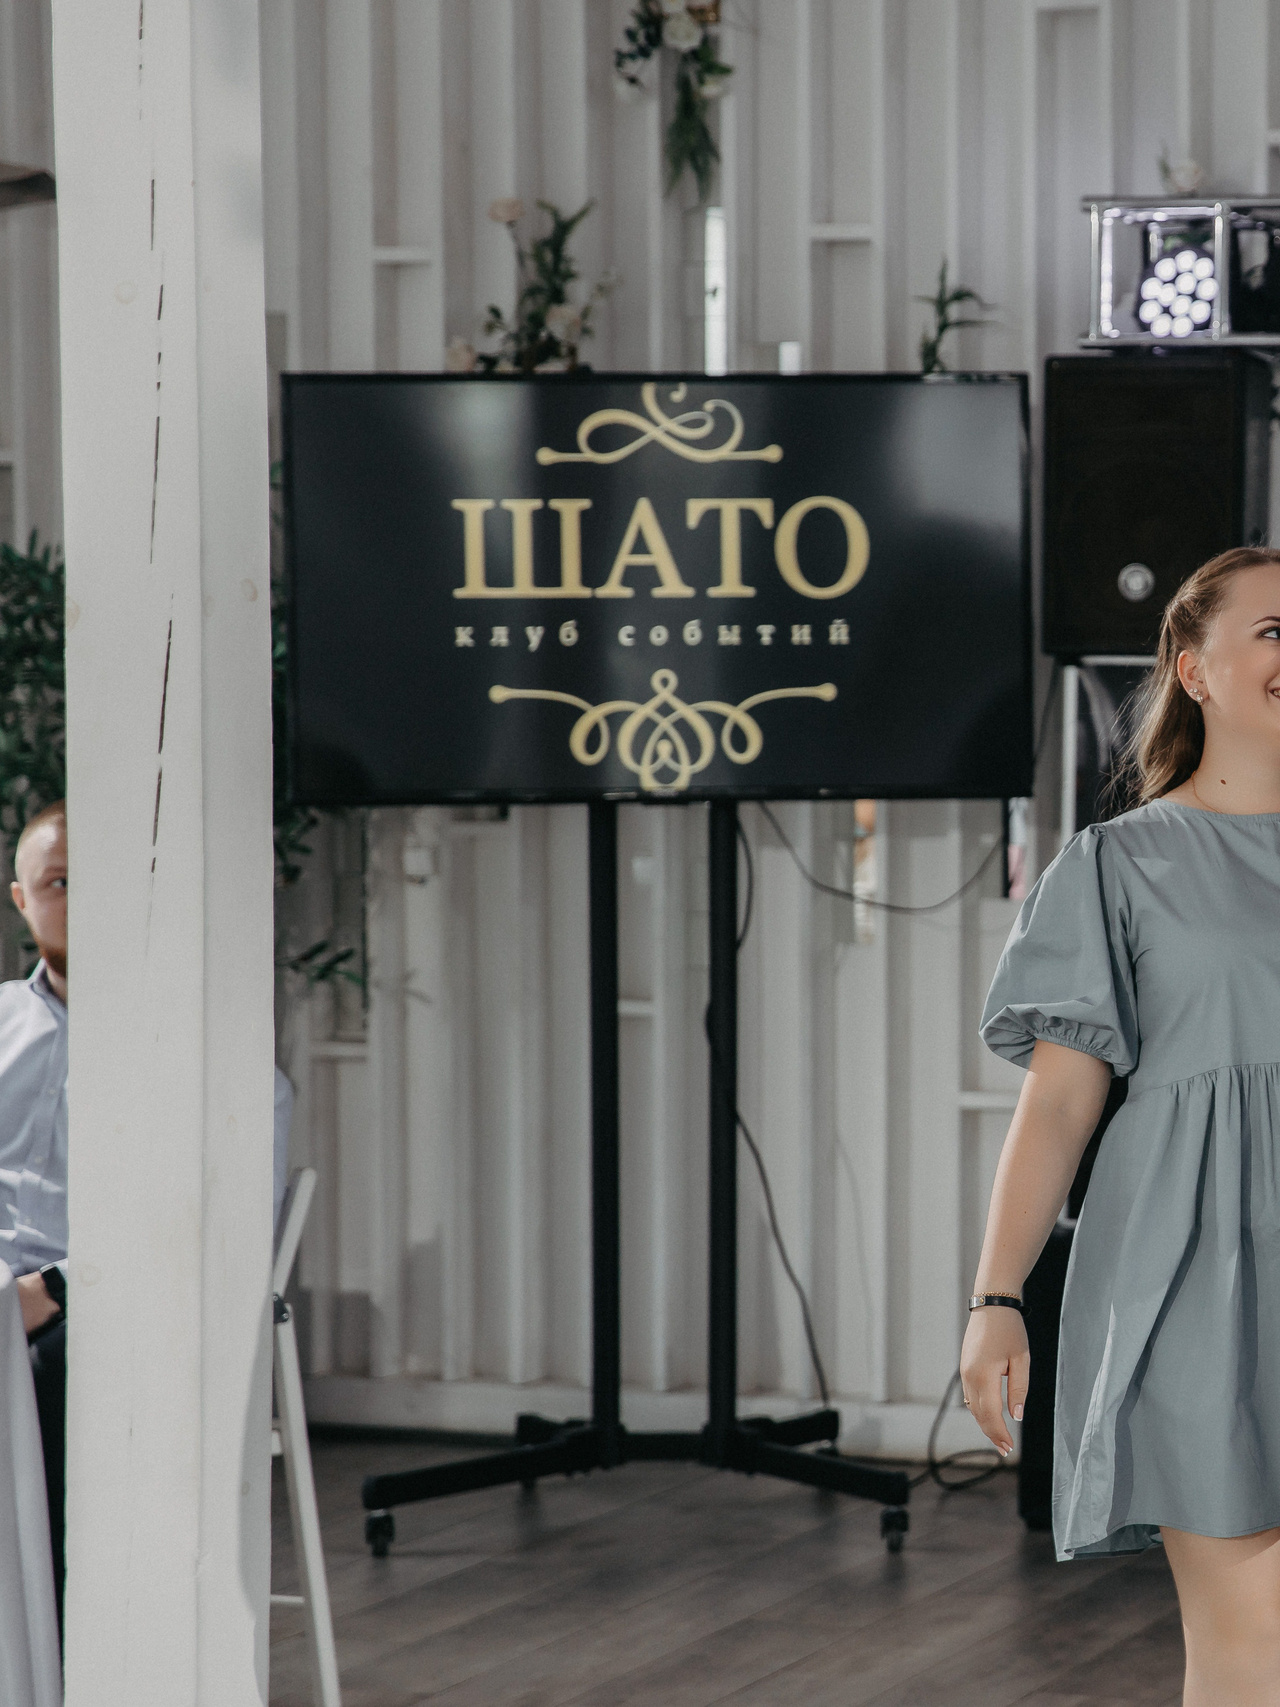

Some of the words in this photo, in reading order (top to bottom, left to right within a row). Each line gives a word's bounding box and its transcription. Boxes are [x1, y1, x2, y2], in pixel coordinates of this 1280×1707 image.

[451, 495, 871, 599] ШАТО
[454, 619, 579, 652] клуб
[617, 618, 851, 647] событий
